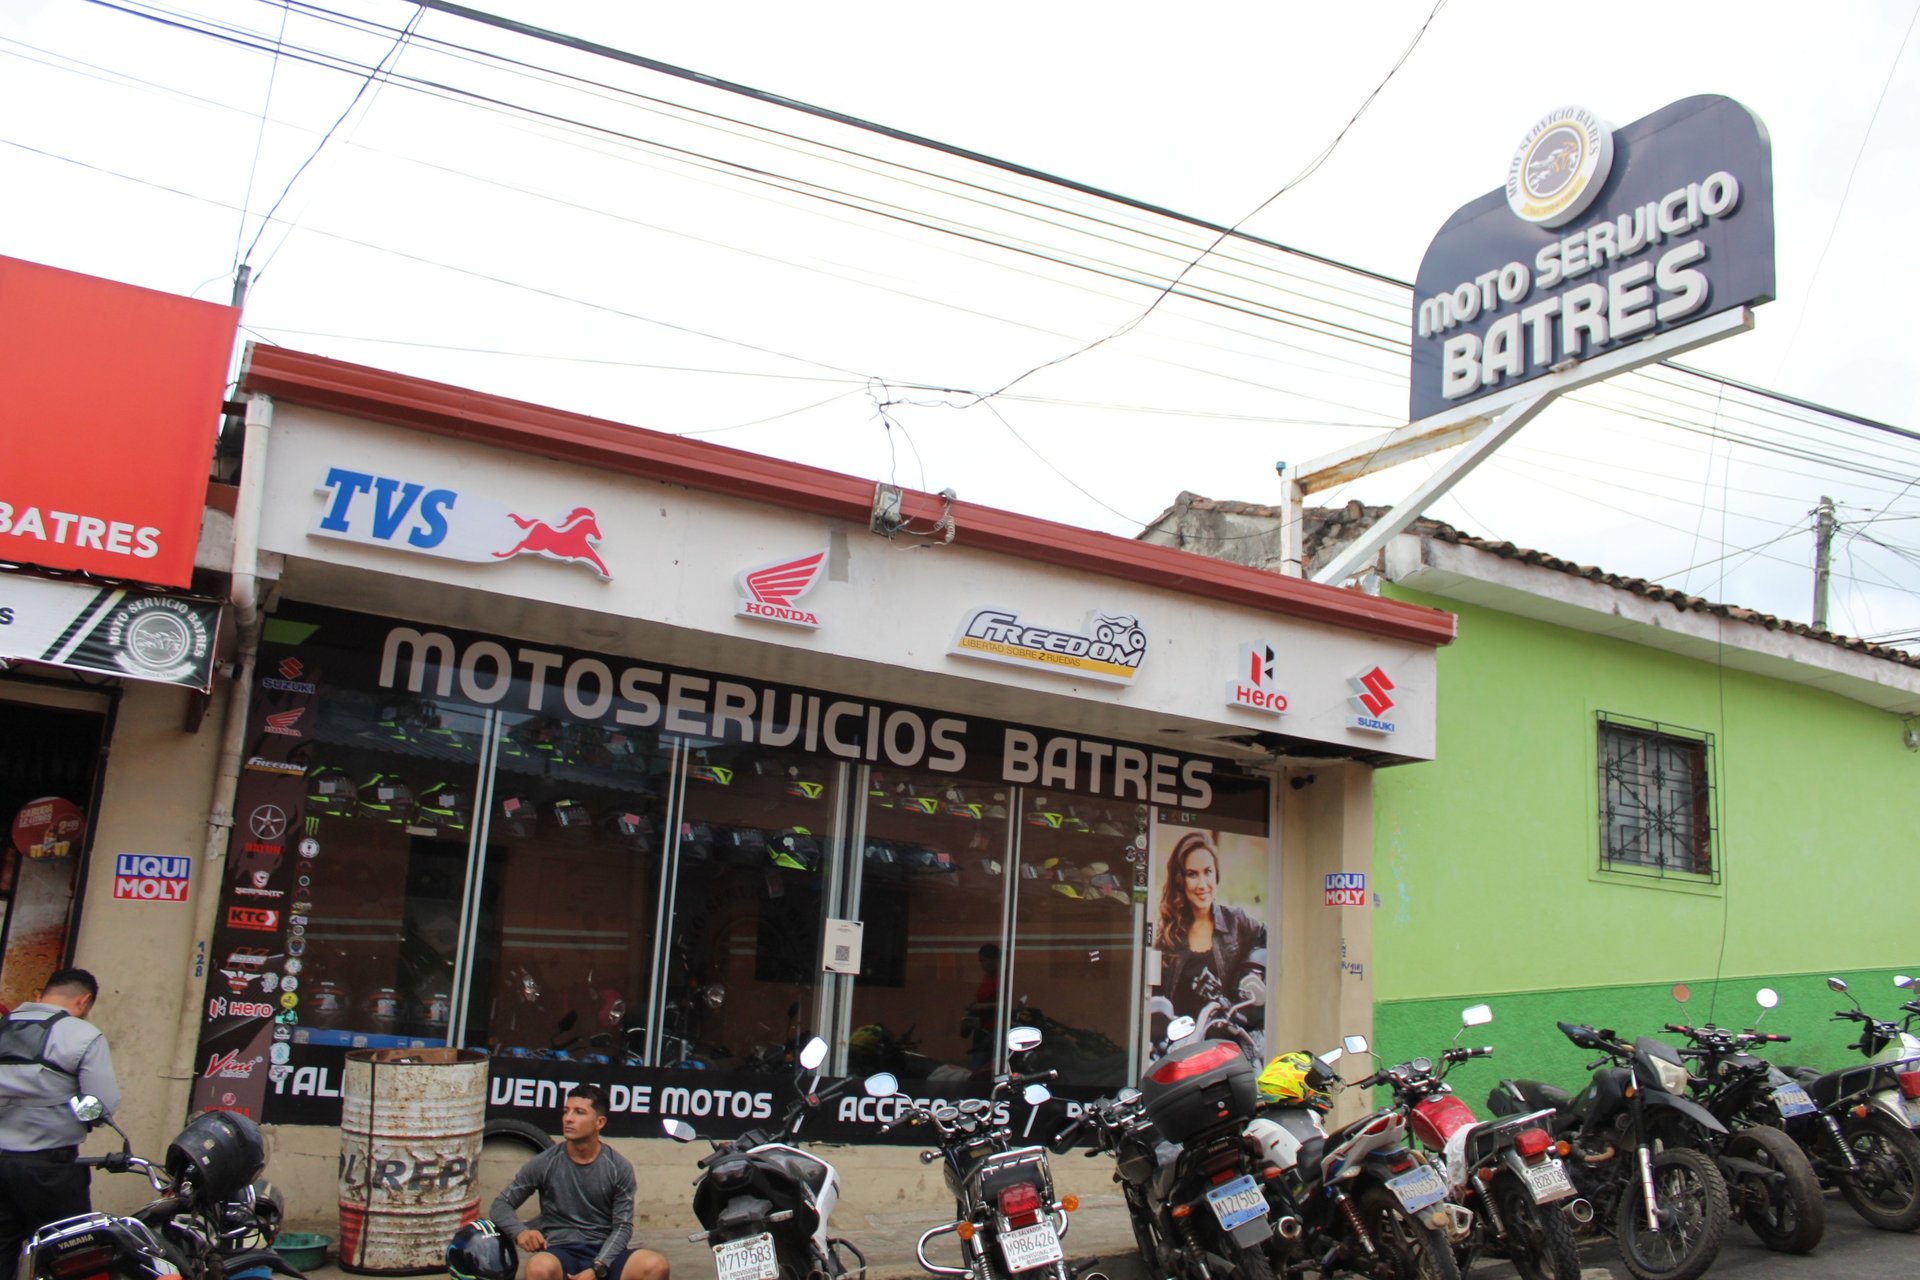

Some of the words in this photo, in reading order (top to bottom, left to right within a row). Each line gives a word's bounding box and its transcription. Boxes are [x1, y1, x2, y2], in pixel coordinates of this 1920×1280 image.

[1418, 261, 1530, 339] MOTO
[1535, 171, 1739, 290] SERVICIO
[1442, 240, 1709, 400] BATRES
[320, 467, 459, 549] TVS
[109, 612, 129, 646] MOTO
[128, 597, 189, 614] SERVICIO
[187, 612, 207, 658] BATRES
[746, 602, 819, 625] HONDA
[961, 637, 1004, 654] LIBERTAD
[1006, 645, 1038, 660] SOBRE
[1038, 652, 1046, 661] 2
[1046, 654, 1081, 667] RUEDAS
[965, 610, 1146, 668] FREEDOM
[262, 677, 316, 695] SUZUKI
[1236, 684, 1288, 712] Hero
[263, 725, 303, 737] HONDA
[378, 626, 968, 773] MOTOSERVICIOS
[1002, 727, 1214, 809] BATRES
[1357, 716, 1395, 732] SUZUKI
[118, 855, 188, 878] LIQUI
[116, 878, 188, 900] MOLY
[1326, 874, 1364, 890] LIQUI
[1325, 889, 1365, 905] MOLY
[204, 1048, 256, 1078] Vini
[490, 1076, 600, 1109] VENT
[609, 1084, 653, 1114] DE
[660, 1087, 773, 1119] MOTOS
[1214, 1186, 1261, 1219] M127505
[57, 1233, 95, 1250] YAMAHA
[1005, 1231, 1055, 1257] M986426
[718, 1244, 772, 1273] M719583
